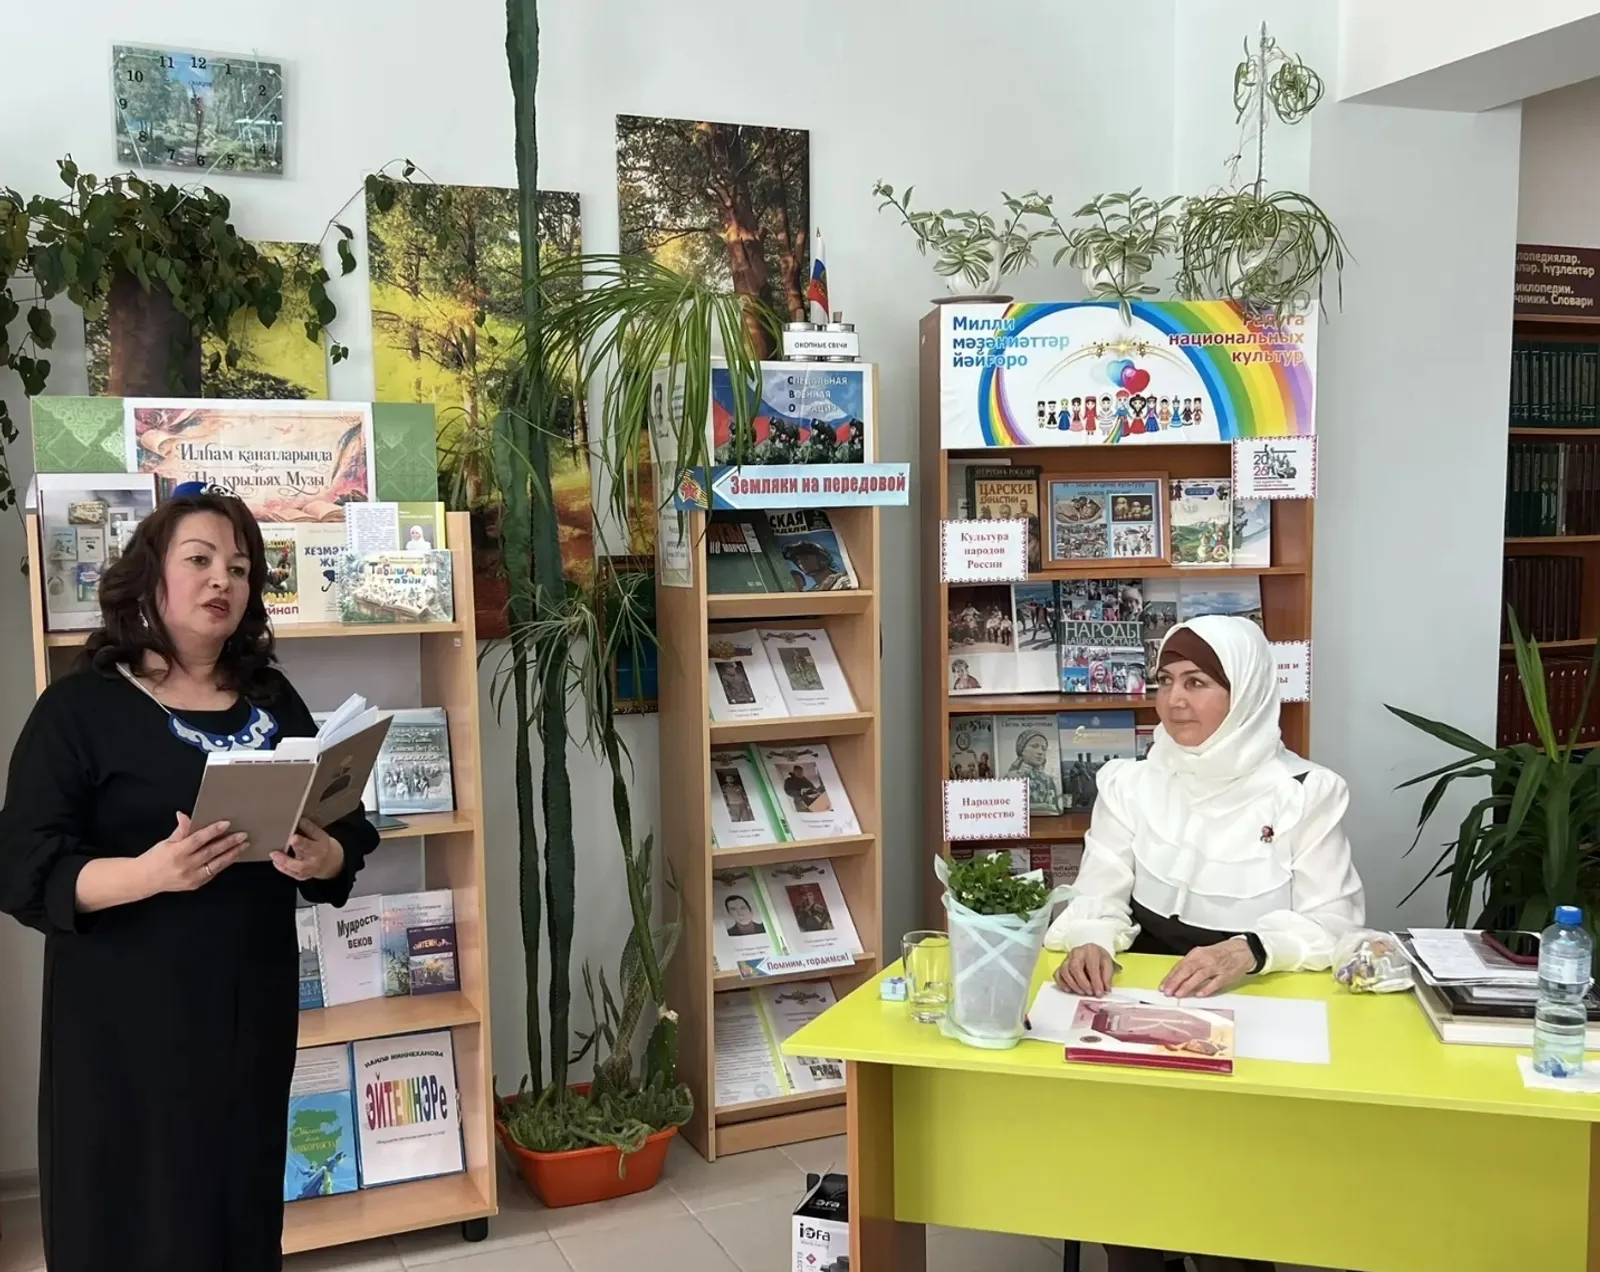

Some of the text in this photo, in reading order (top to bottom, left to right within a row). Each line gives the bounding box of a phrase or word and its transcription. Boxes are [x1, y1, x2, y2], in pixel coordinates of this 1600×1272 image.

[159, 56, 175, 69] 11
[190, 57, 207, 70] 12
[224, 63, 232, 75] 1
[127, 70, 144, 83] 10
[258, 85, 267, 96] 2
[119, 98, 128, 110] 9
[138, 131, 148, 143] 8
[258, 143, 267, 154] 4
[167, 149, 176, 161] 7
[196, 155, 206, 167] 6
[226, 154, 235, 166] 5
[1551, 294, 1594, 309] Словари
[952, 315, 1016, 331] Милли
[794, 340, 848, 349] ОКОПНЫЕ СВЕЧИ
[952, 335, 1070, 352] мәҙәниәттәр
[1169, 331, 1304, 346] национальных
[952, 352, 1028, 370] йәйғоро
[1232, 350, 1304, 365] культур
[788, 389, 831, 399] ВОЕННАЯ
[222, 475, 281, 490] крыльях
[285, 471, 325, 488] Музы
[730, 473, 906, 494] Земляки на передовой
[980, 484, 1034, 495] ЦАРСКИЕ
[980, 496, 1018, 505] ДИНАСТИИ
[769, 512, 804, 528] СКАЯ
[961, 533, 1009, 543] Культура
[964, 547, 1005, 556] народов
[967, 560, 1002, 569] России
[1064, 622, 1141, 640] НАРОДЫ
[1064, 637, 1142, 648] БАШКОРТОСТАНА
[962, 797, 1010, 807] Народное
[959, 811, 1015, 821] творчество
[336, 914, 379, 938] Мудрость
[767, 953, 849, 972] Помним, гордимся!
